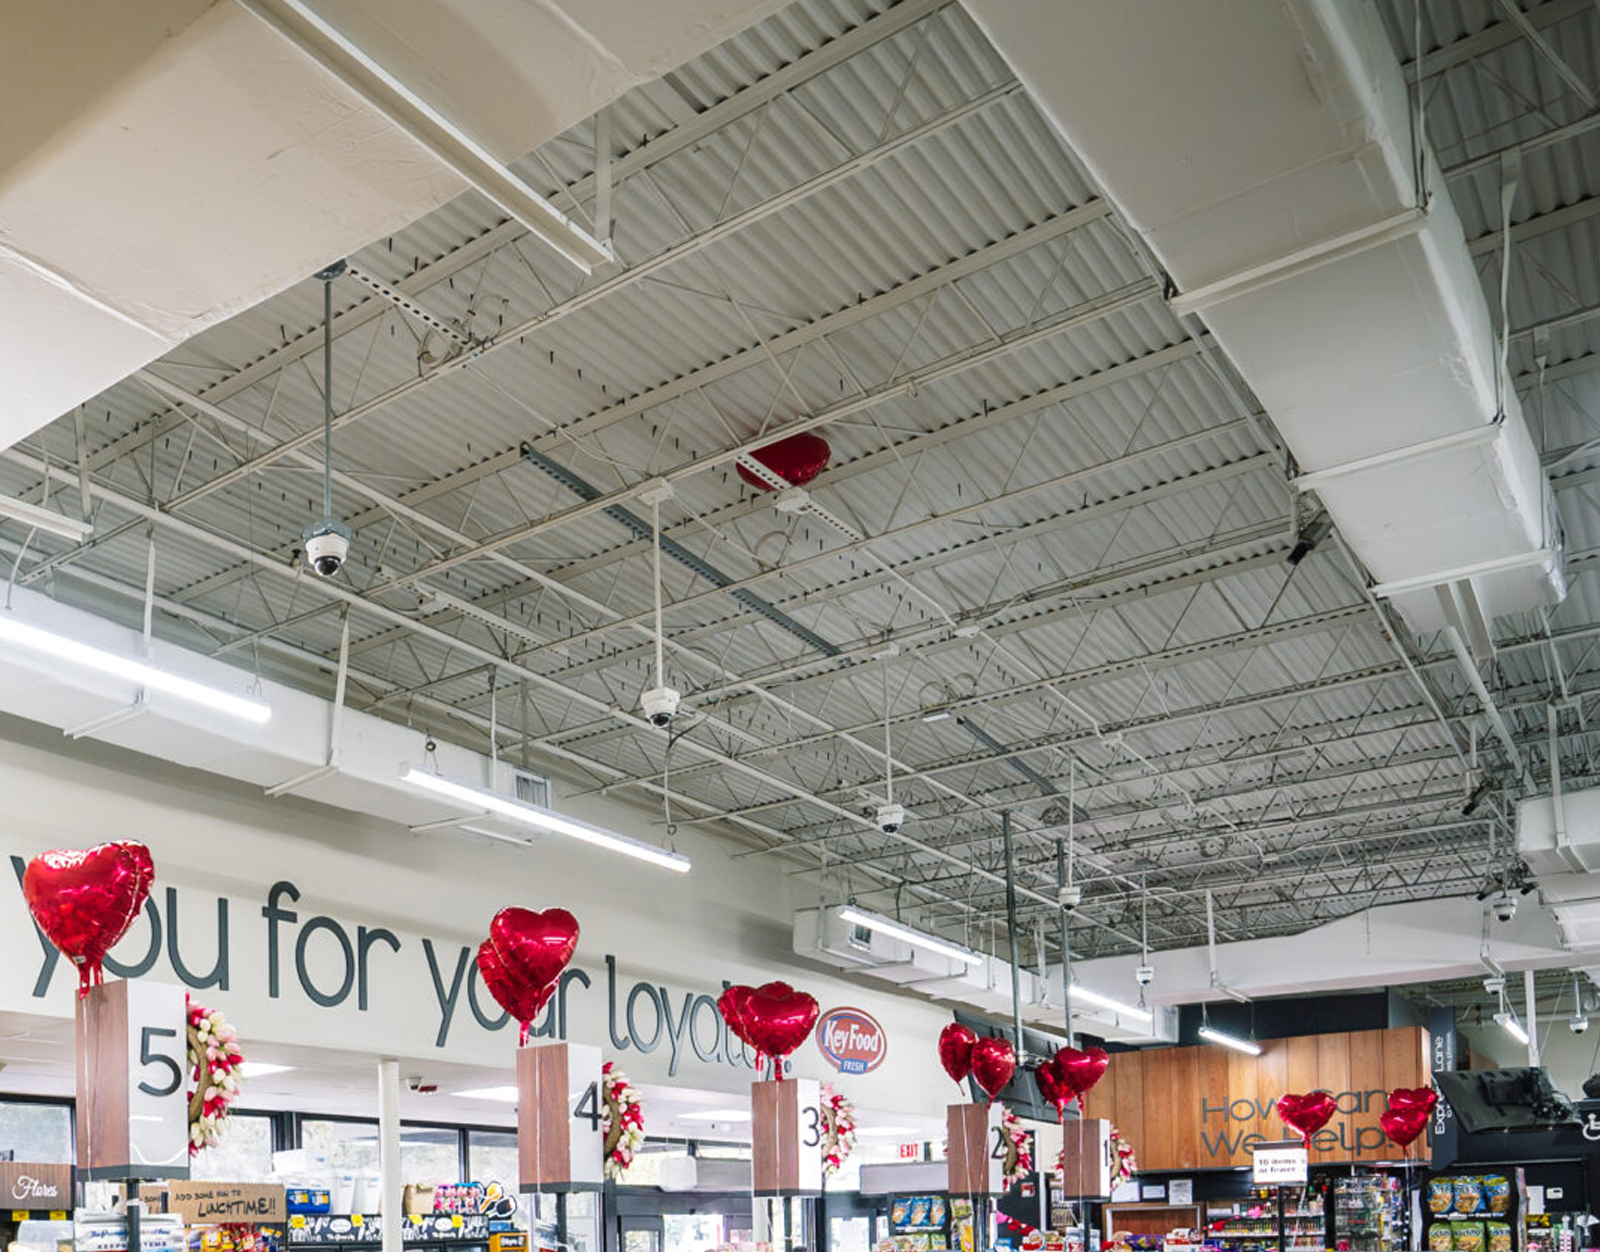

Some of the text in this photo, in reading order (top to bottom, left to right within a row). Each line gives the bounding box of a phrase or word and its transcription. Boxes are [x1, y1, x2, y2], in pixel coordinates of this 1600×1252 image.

[262, 880, 401, 1010] for
[825, 1019, 879, 1054] Key Food
[1434, 1035, 1444, 1072] Lane
[139, 1027, 182, 1097] 5
[573, 1081, 600, 1131] 4
[1310, 1088, 1389, 1115] an
[802, 1106, 820, 1147] 3
[990, 1126, 1005, 1159] 2
[1202, 1121, 1394, 1158] We elp
[900, 1143, 919, 1158] EXIT
[1103, 1139, 1109, 1167] 1
[175, 1192, 191, 1201] ADD
[194, 1192, 214, 1200] SOME
[198, 1197, 276, 1217] LUNCHTIME!!
